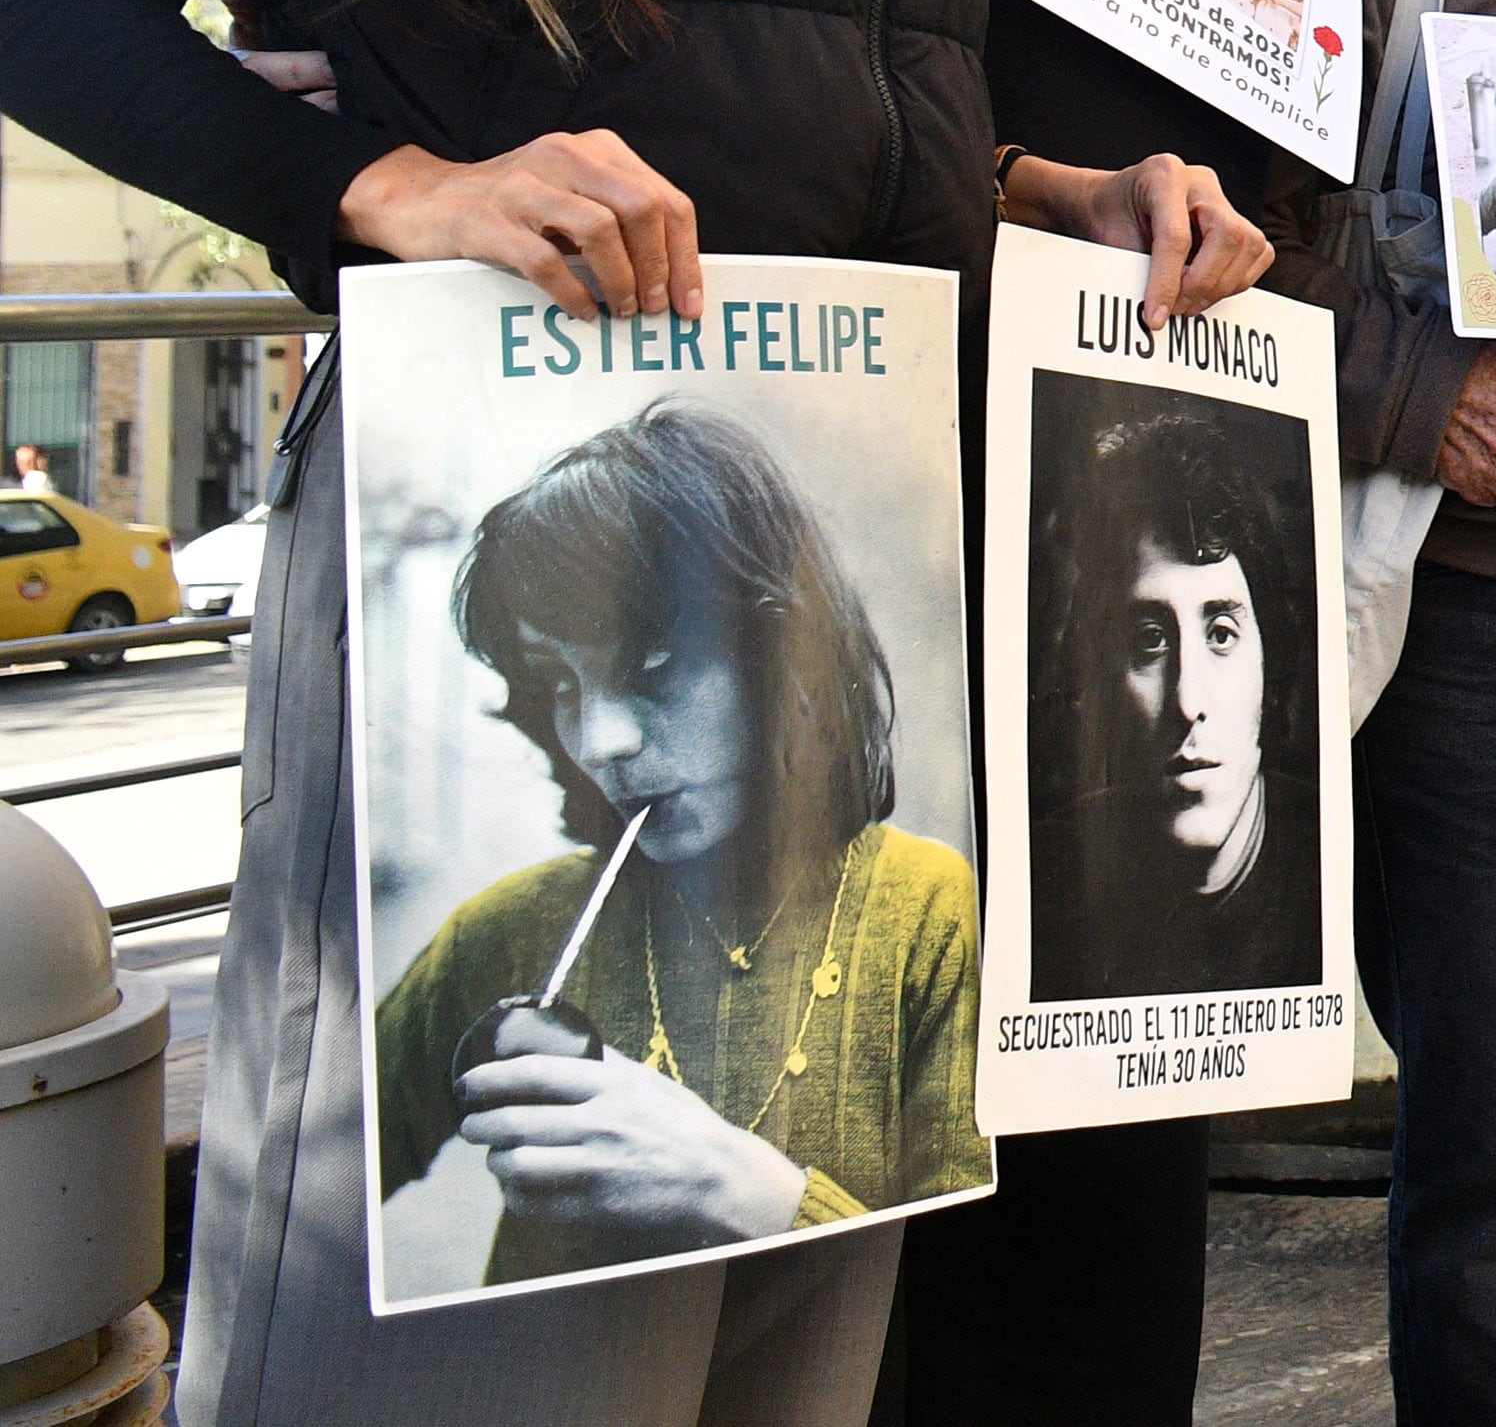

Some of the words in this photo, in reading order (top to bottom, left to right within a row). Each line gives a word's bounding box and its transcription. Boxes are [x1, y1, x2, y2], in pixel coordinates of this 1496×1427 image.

[1130, 13, 1159, 37] no
[1170, 34, 1210, 68] fue
[1209, 7, 1234, 33] de
[1243, 25, 1294, 69] 2026
[500, 302, 705, 378] ESTER
[722, 301, 886, 375] FELIPE
[1078, 290, 1155, 360] LUIS
[998, 1008, 1132, 1053] SECUESTRADO
[1145, 1006, 1165, 1041] EL
[1170, 1005, 1189, 1039] 11
[1195, 1003, 1217, 1037] DE
[1222, 998, 1276, 1036] ENERO
[1282, 997, 1302, 1030] DE
[1306, 993, 1343, 1028] 1978
[1116, 1043, 1167, 1089] TENÍA
[1172, 1048, 1196, 1083] 30
[1199, 1039, 1246, 1081] AÑOS
